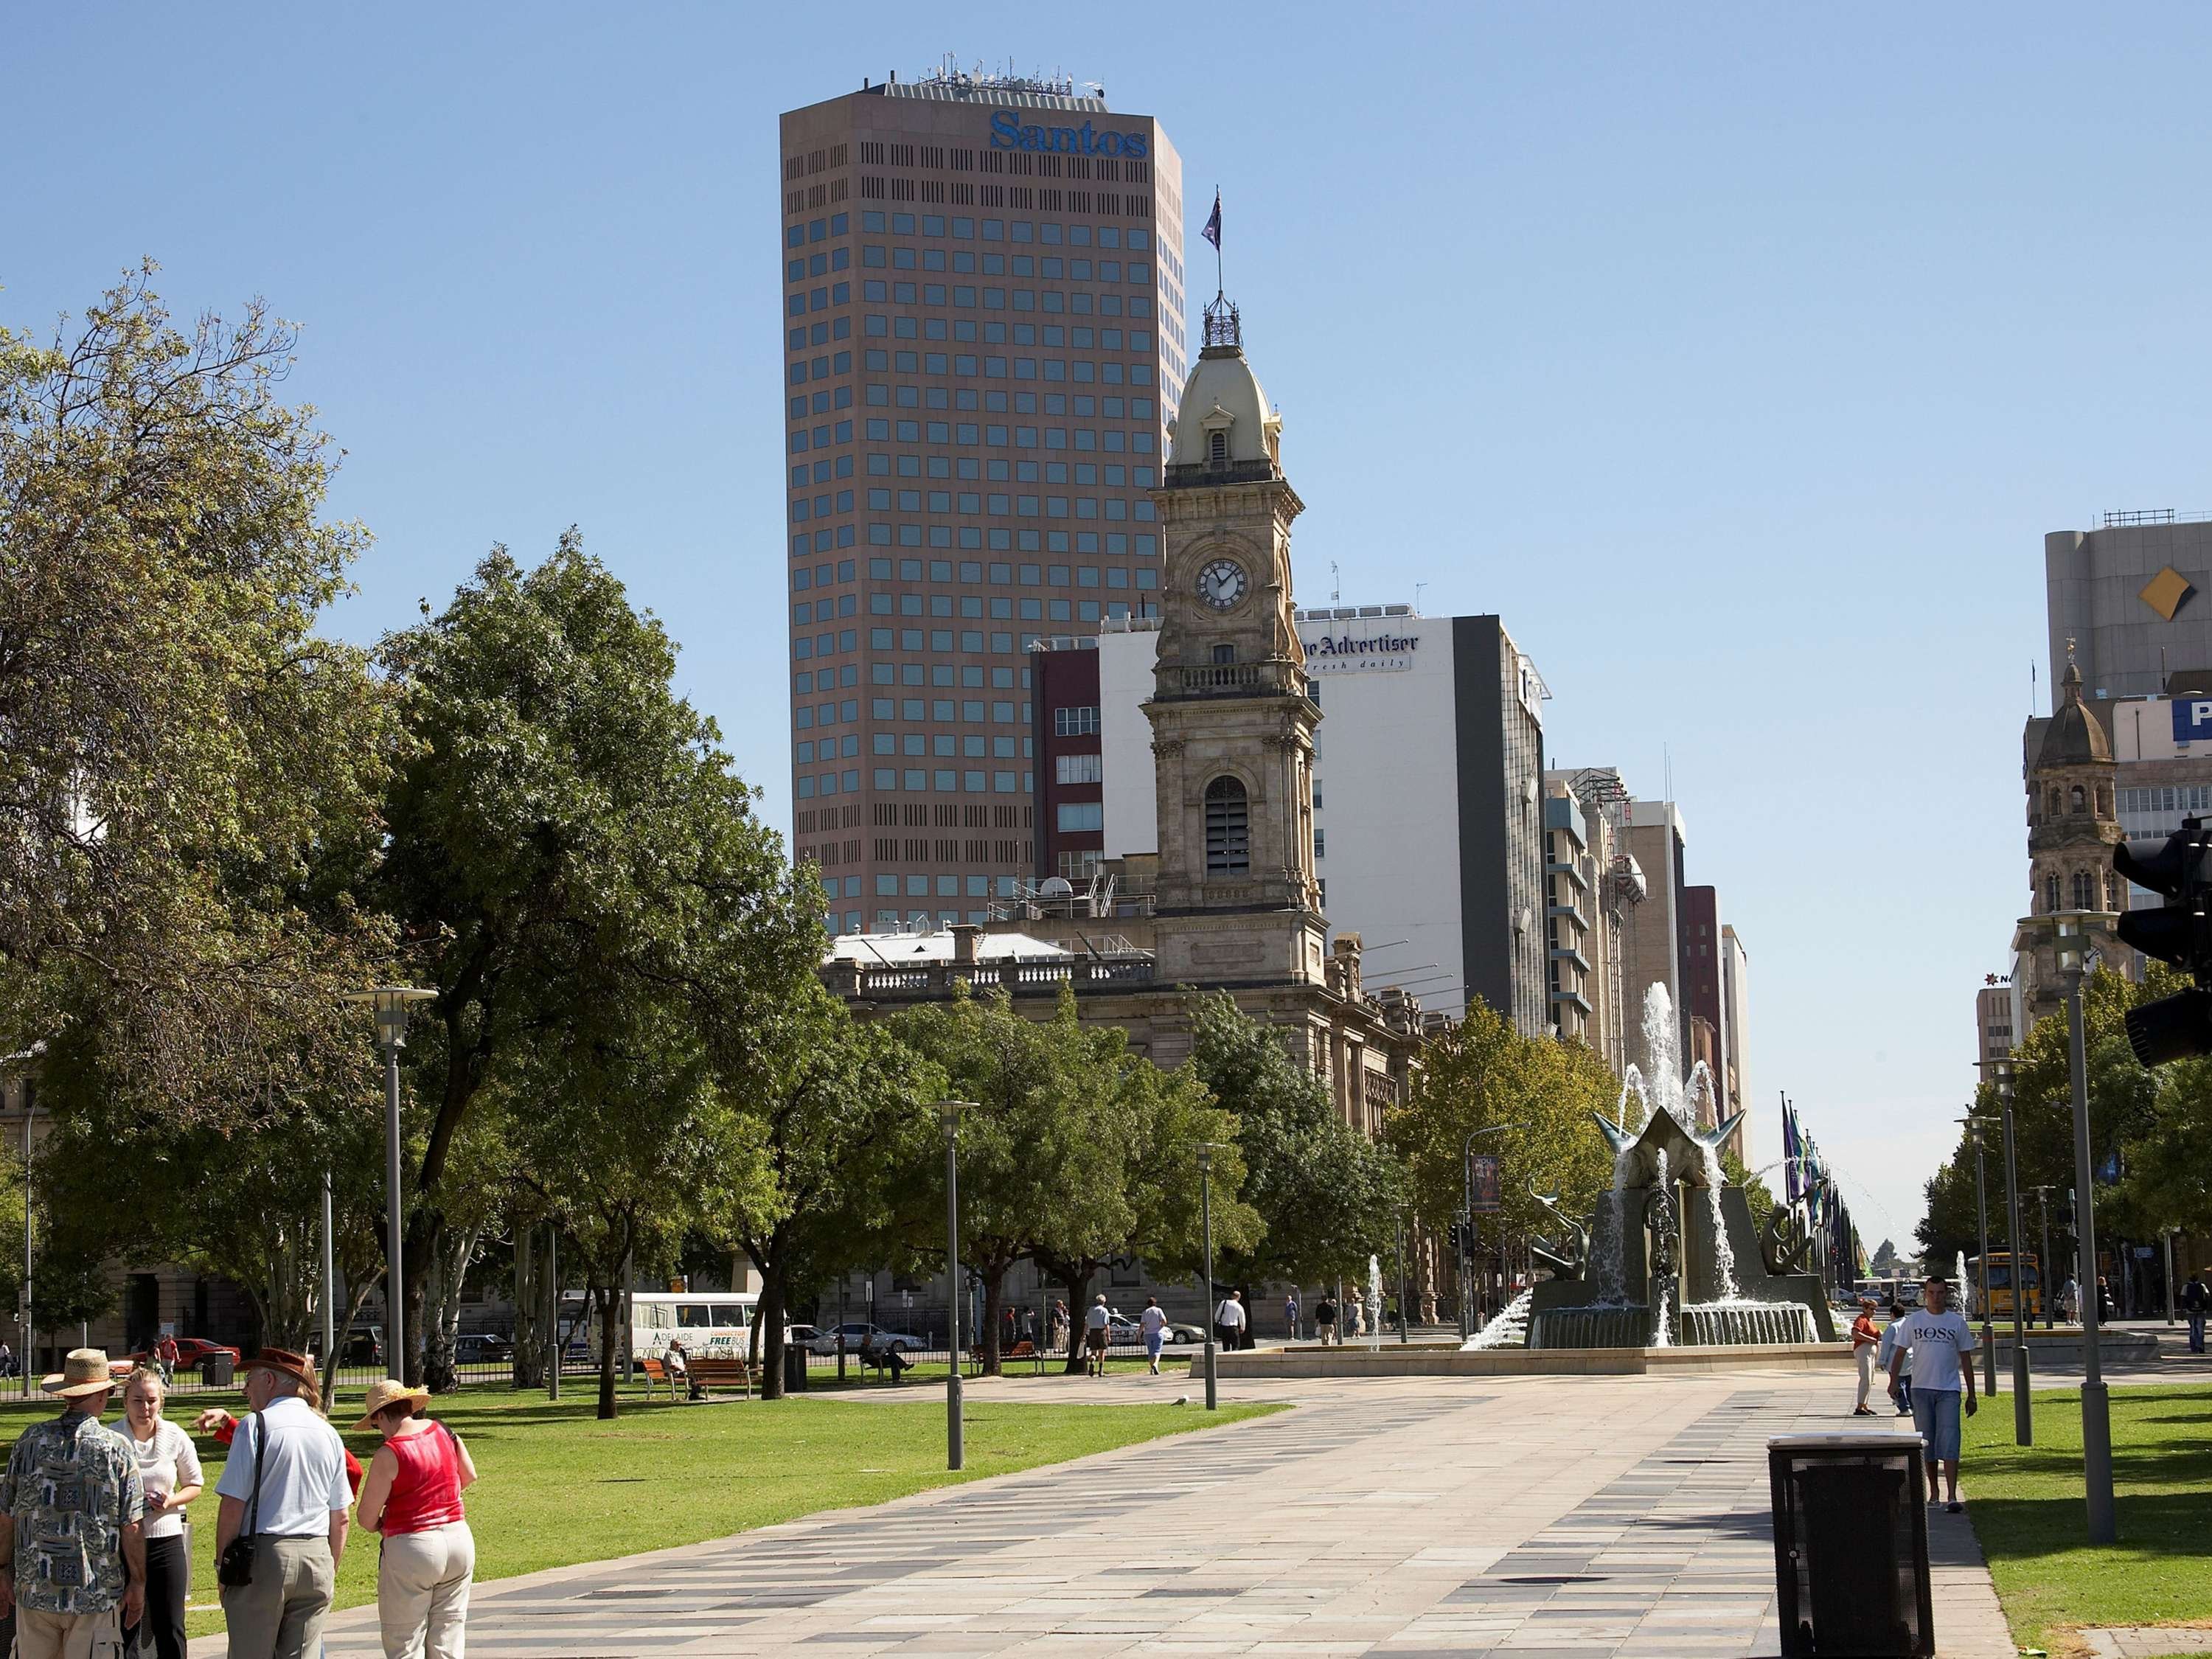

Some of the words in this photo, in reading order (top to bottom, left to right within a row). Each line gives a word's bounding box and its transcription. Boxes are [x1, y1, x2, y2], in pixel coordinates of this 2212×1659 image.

[990, 110, 1147, 159] Santos
[1320, 634, 1419, 656] Advertiser
[1360, 659, 1404, 668] daily
[653, 1332, 694, 1345] ADELAIDE
[1914, 1327, 1955, 1340] BOSS
